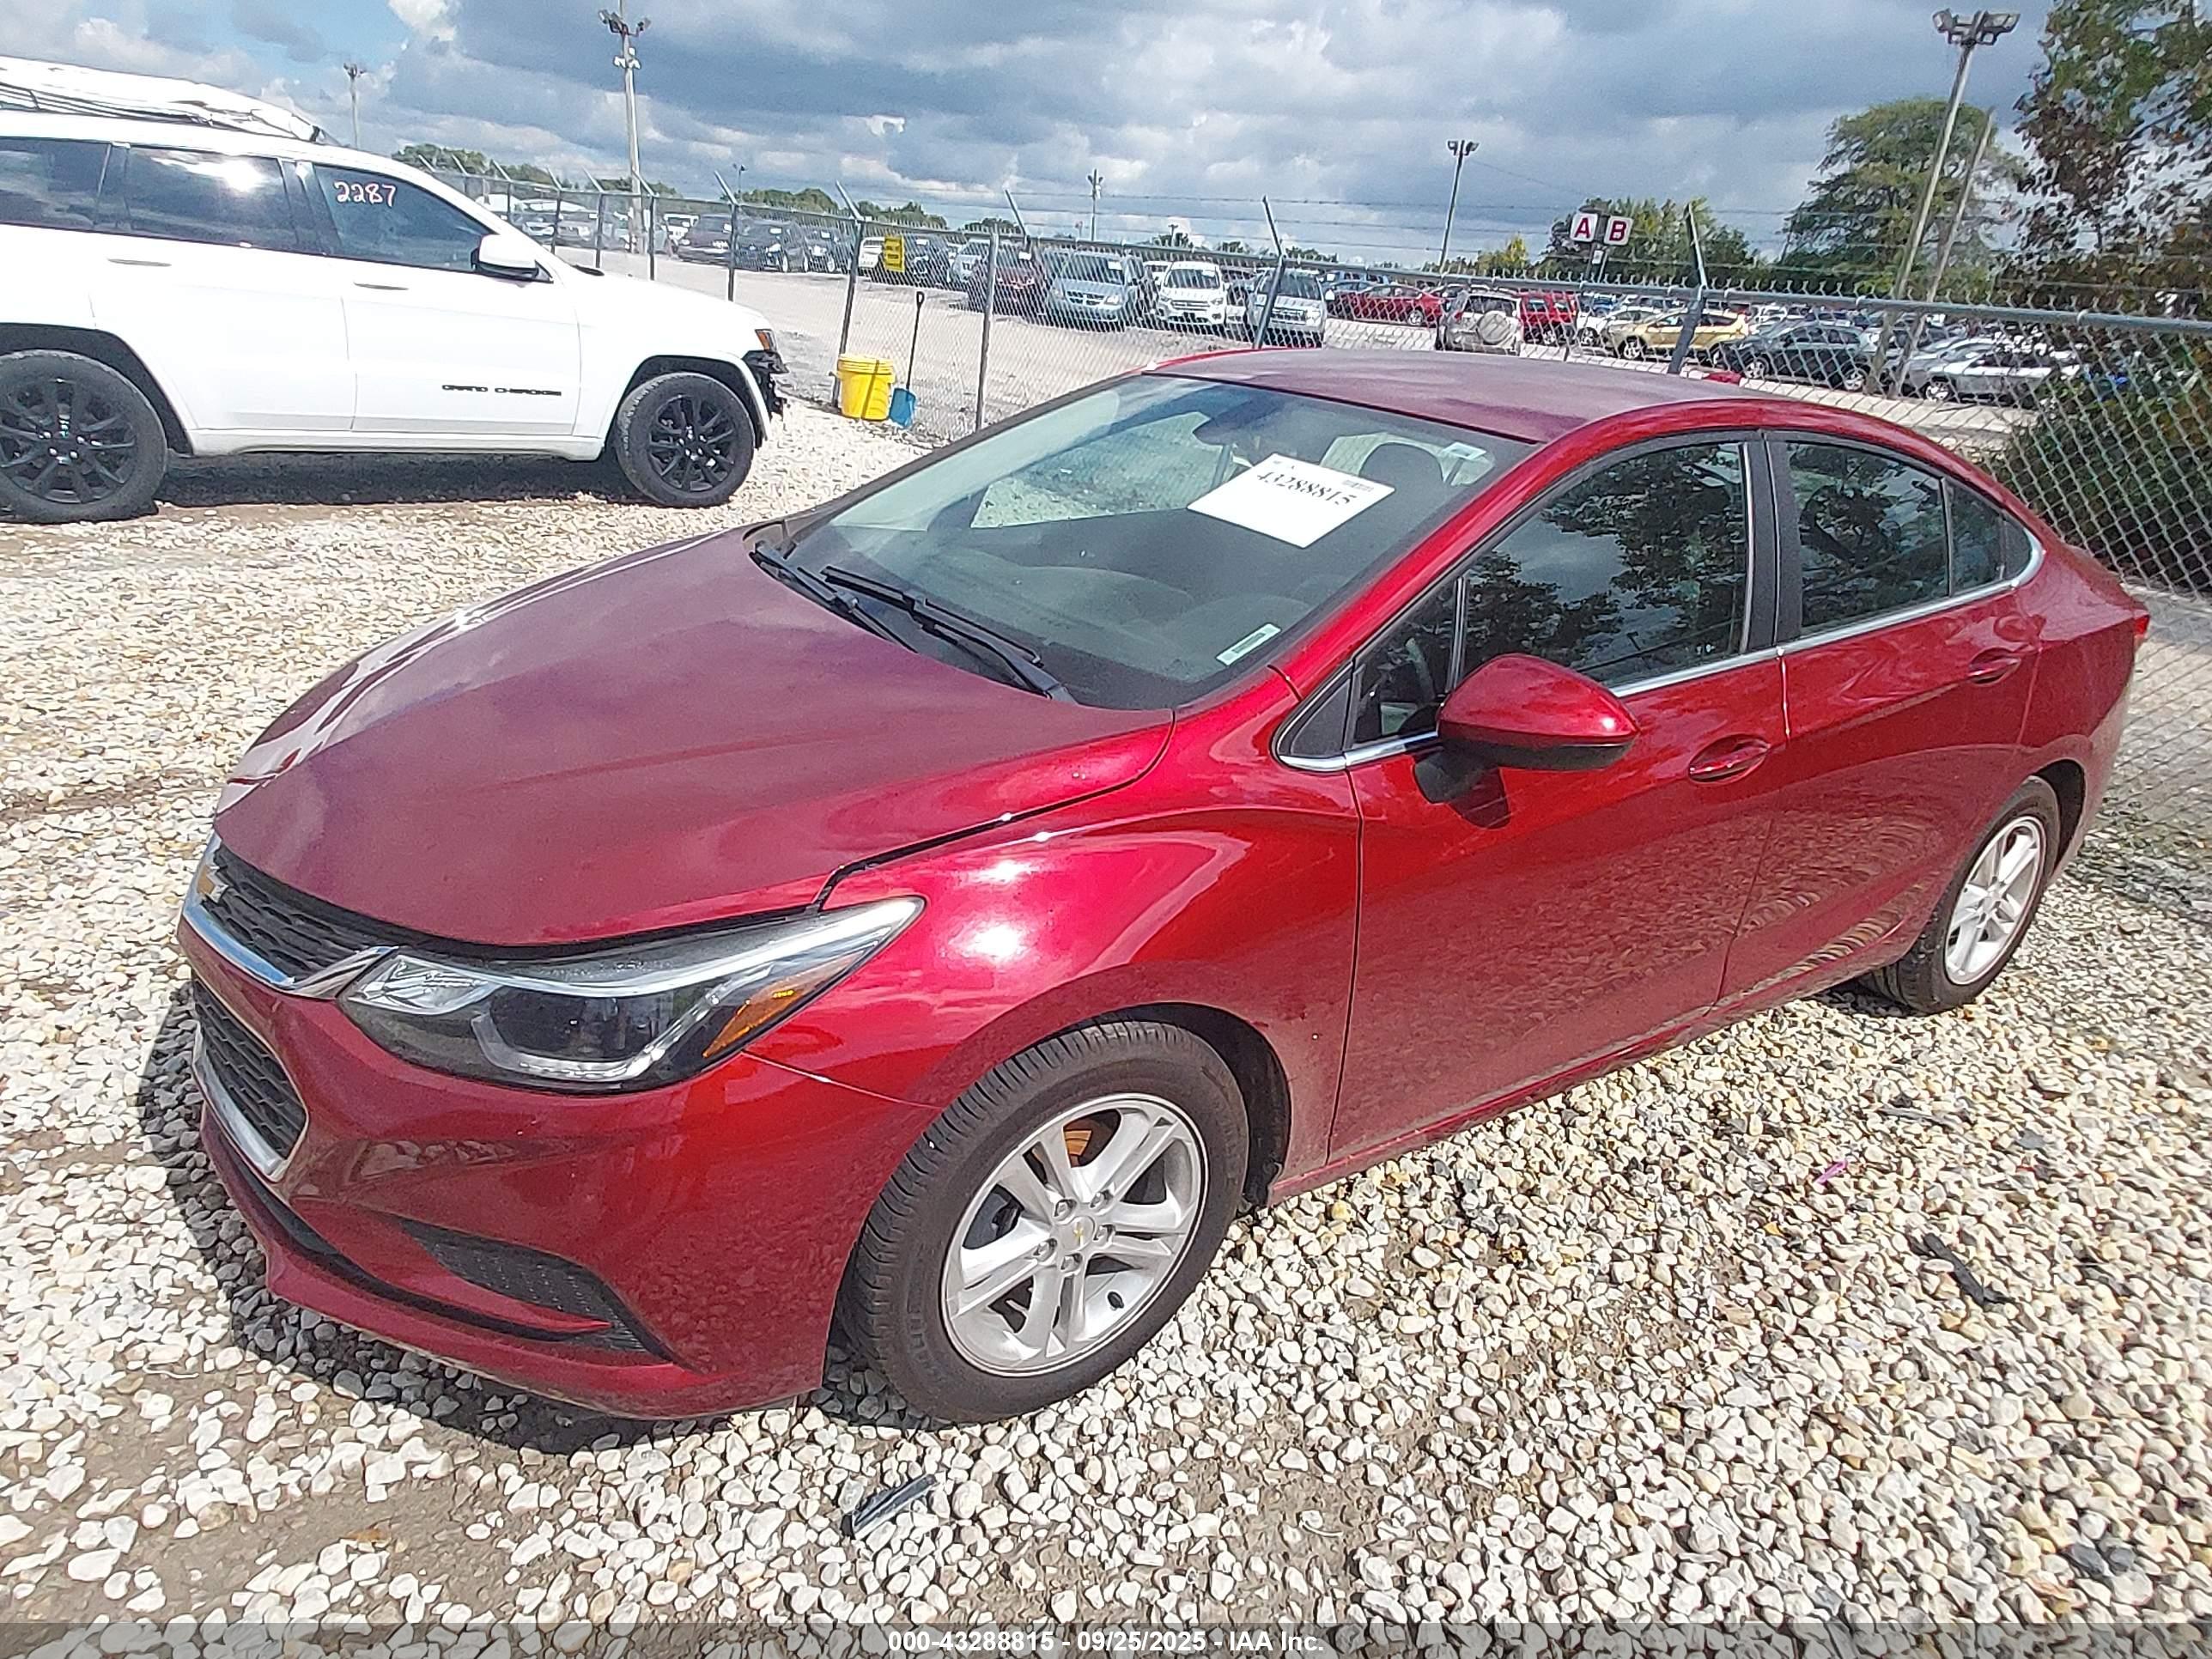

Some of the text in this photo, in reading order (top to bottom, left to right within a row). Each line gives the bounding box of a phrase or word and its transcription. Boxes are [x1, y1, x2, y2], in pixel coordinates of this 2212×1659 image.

[333, 180, 397, 208] 2287
[1574, 217, 1591, 239] A
[1609, 220, 1627, 241] B
[1256, 471, 1358, 505] 43288815
